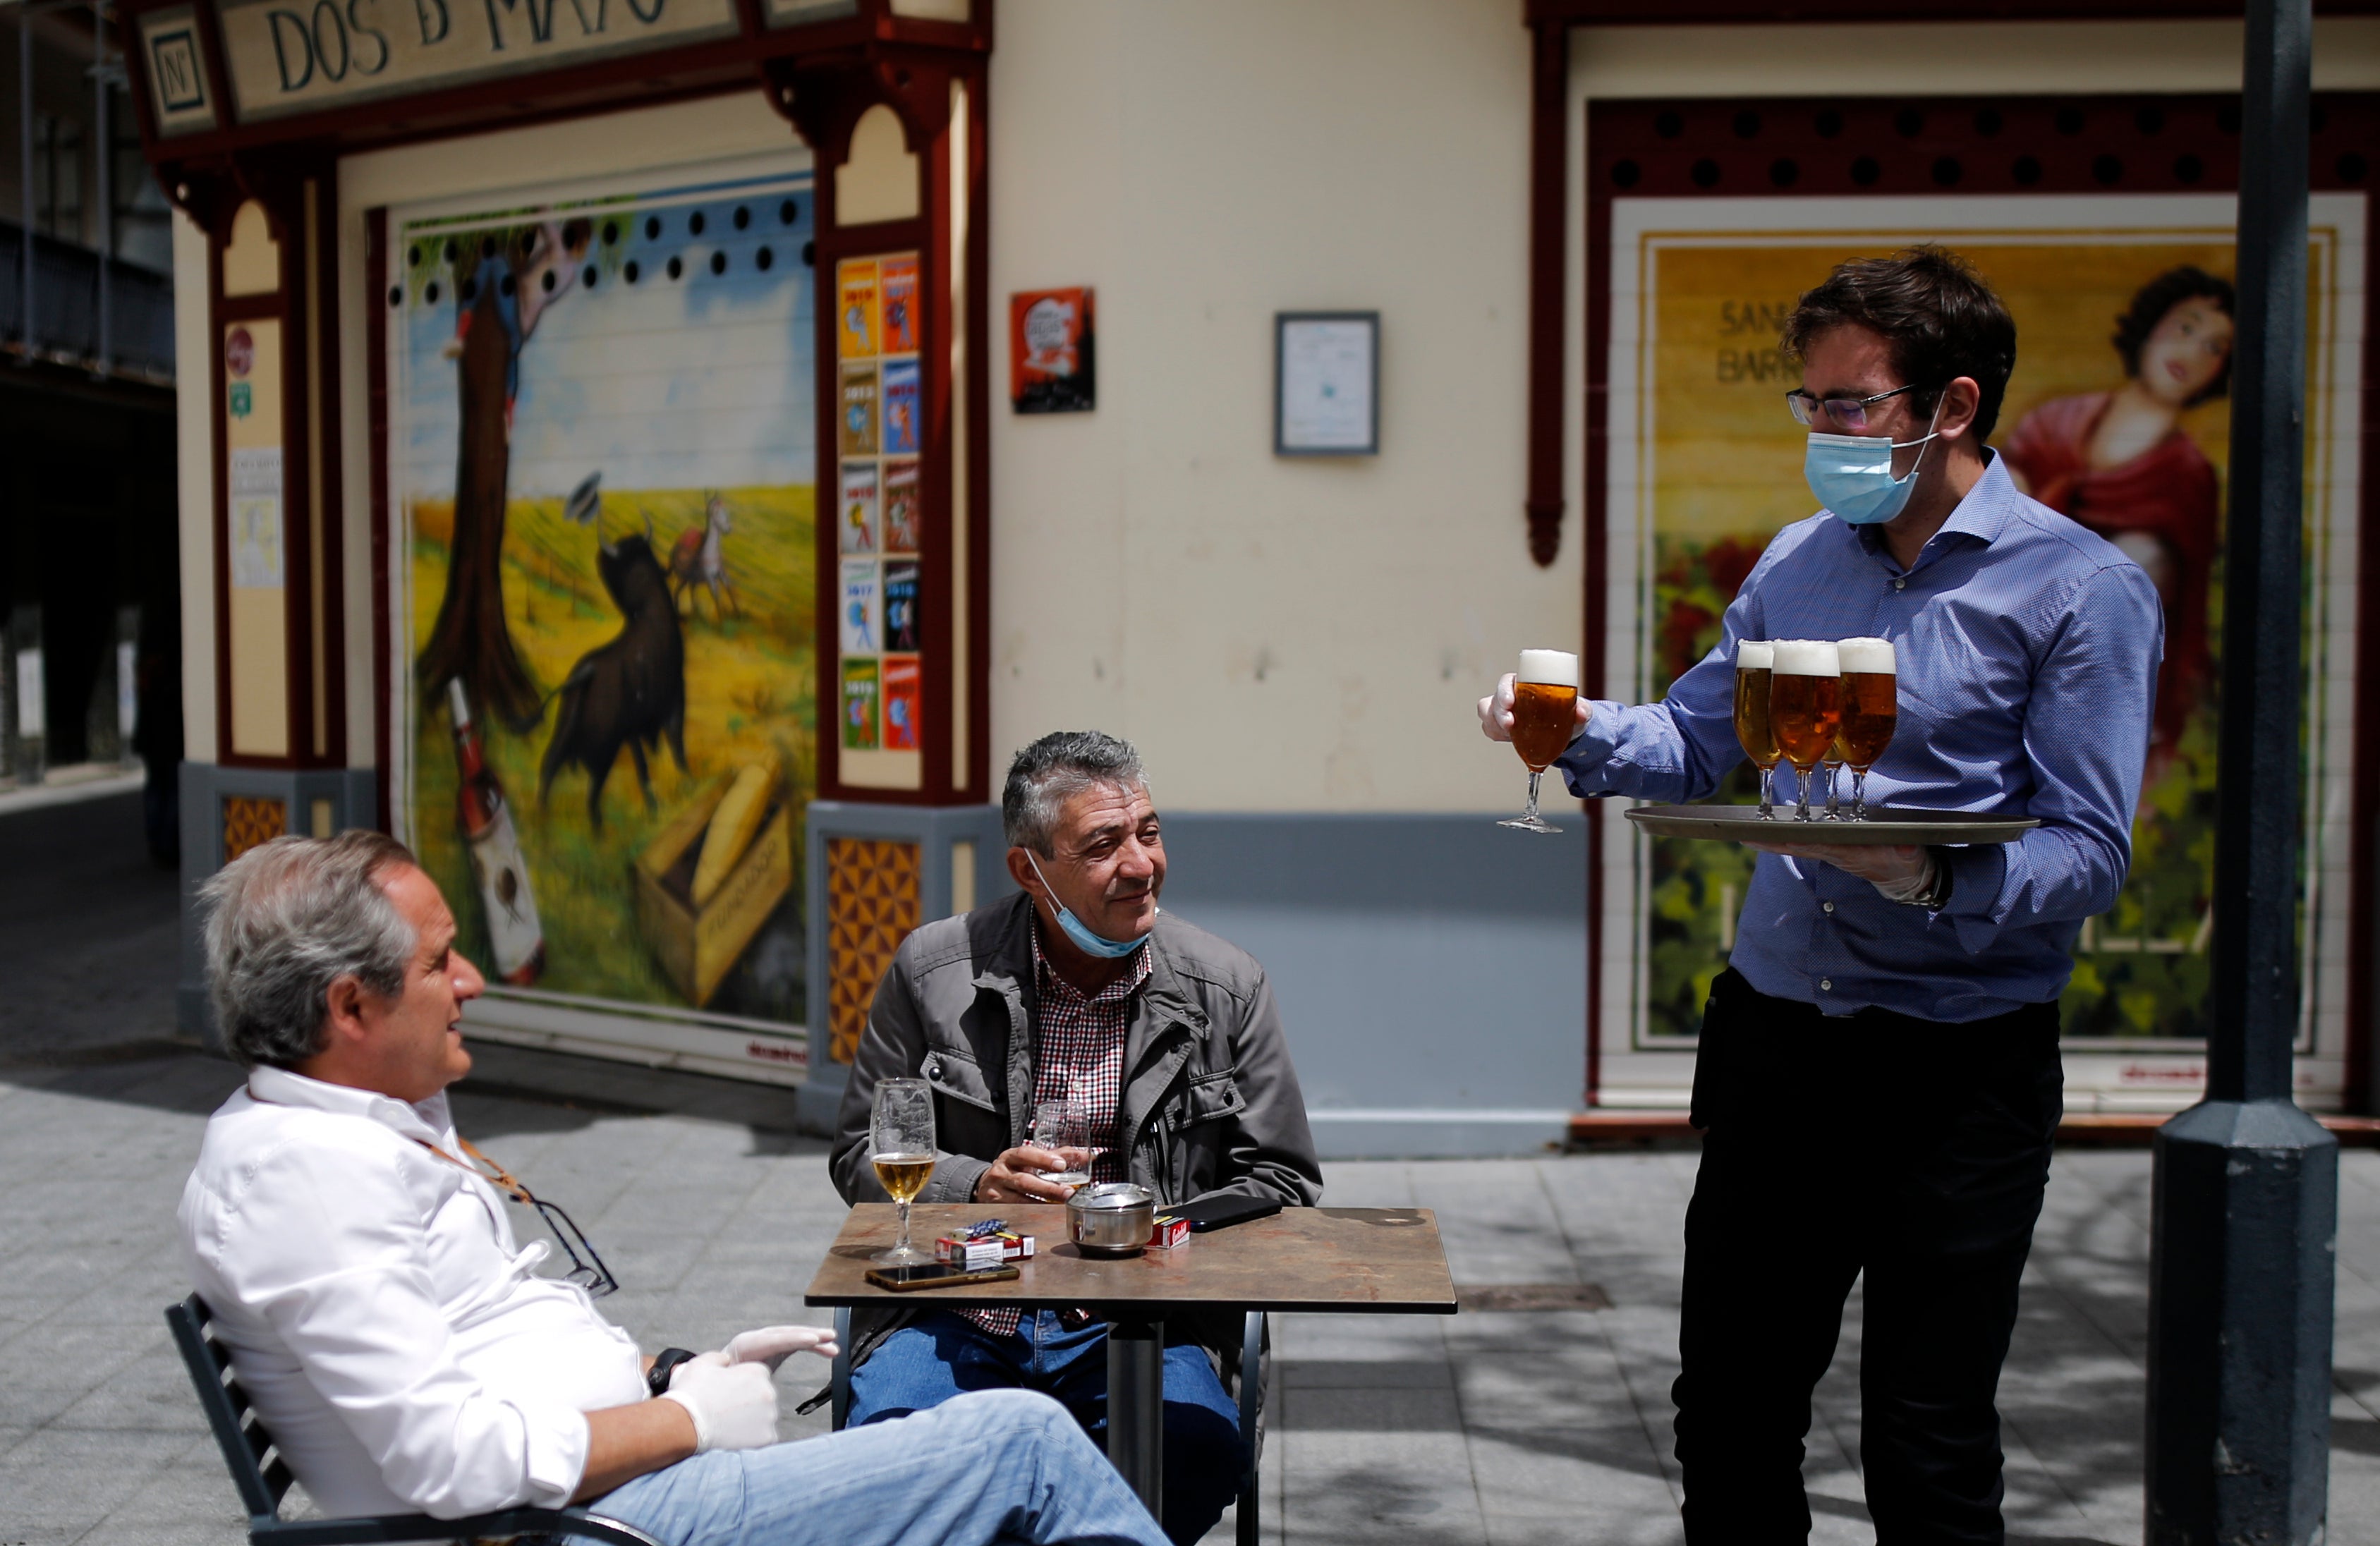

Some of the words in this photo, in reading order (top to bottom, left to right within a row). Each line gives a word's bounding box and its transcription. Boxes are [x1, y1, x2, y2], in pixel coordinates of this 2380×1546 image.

[265, 0, 389, 92] DOS
[1718, 299, 1786, 336] SAN
[1717, 348, 1803, 382] BARR
